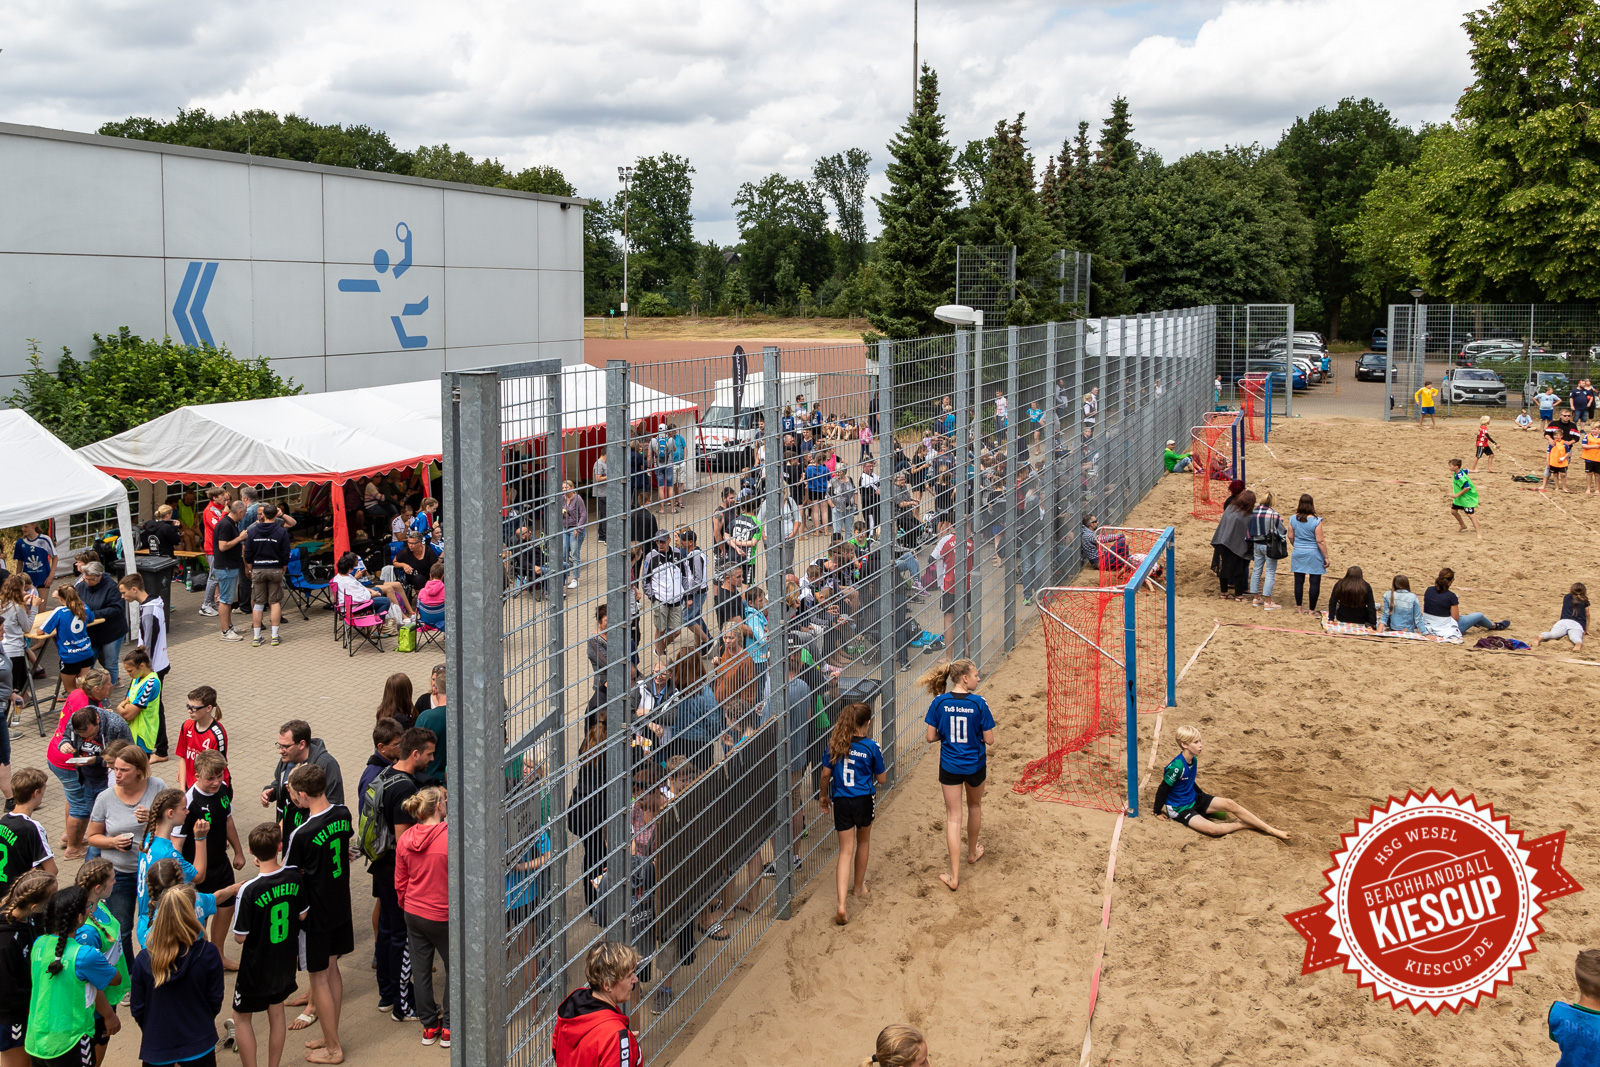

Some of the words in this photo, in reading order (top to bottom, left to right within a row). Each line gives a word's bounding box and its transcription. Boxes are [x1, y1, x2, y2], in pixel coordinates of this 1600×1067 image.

[70, 615, 85, 634] 6
[943, 705, 955, 713] TuS
[956, 706, 974, 714] Ickern
[949, 716, 968, 743] 10
[202, 738, 211, 750] 4
[849, 749, 867, 759] ckern
[842, 758, 855, 787] 6
[312, 831, 329, 846] VFL
[326, 819, 350, 836] WELFIA
[329, 837, 342, 879] 3
[254, 891, 273, 908] VFL
[271, 882, 300, 899] WELFIA
[269, 901, 289, 944] 8
